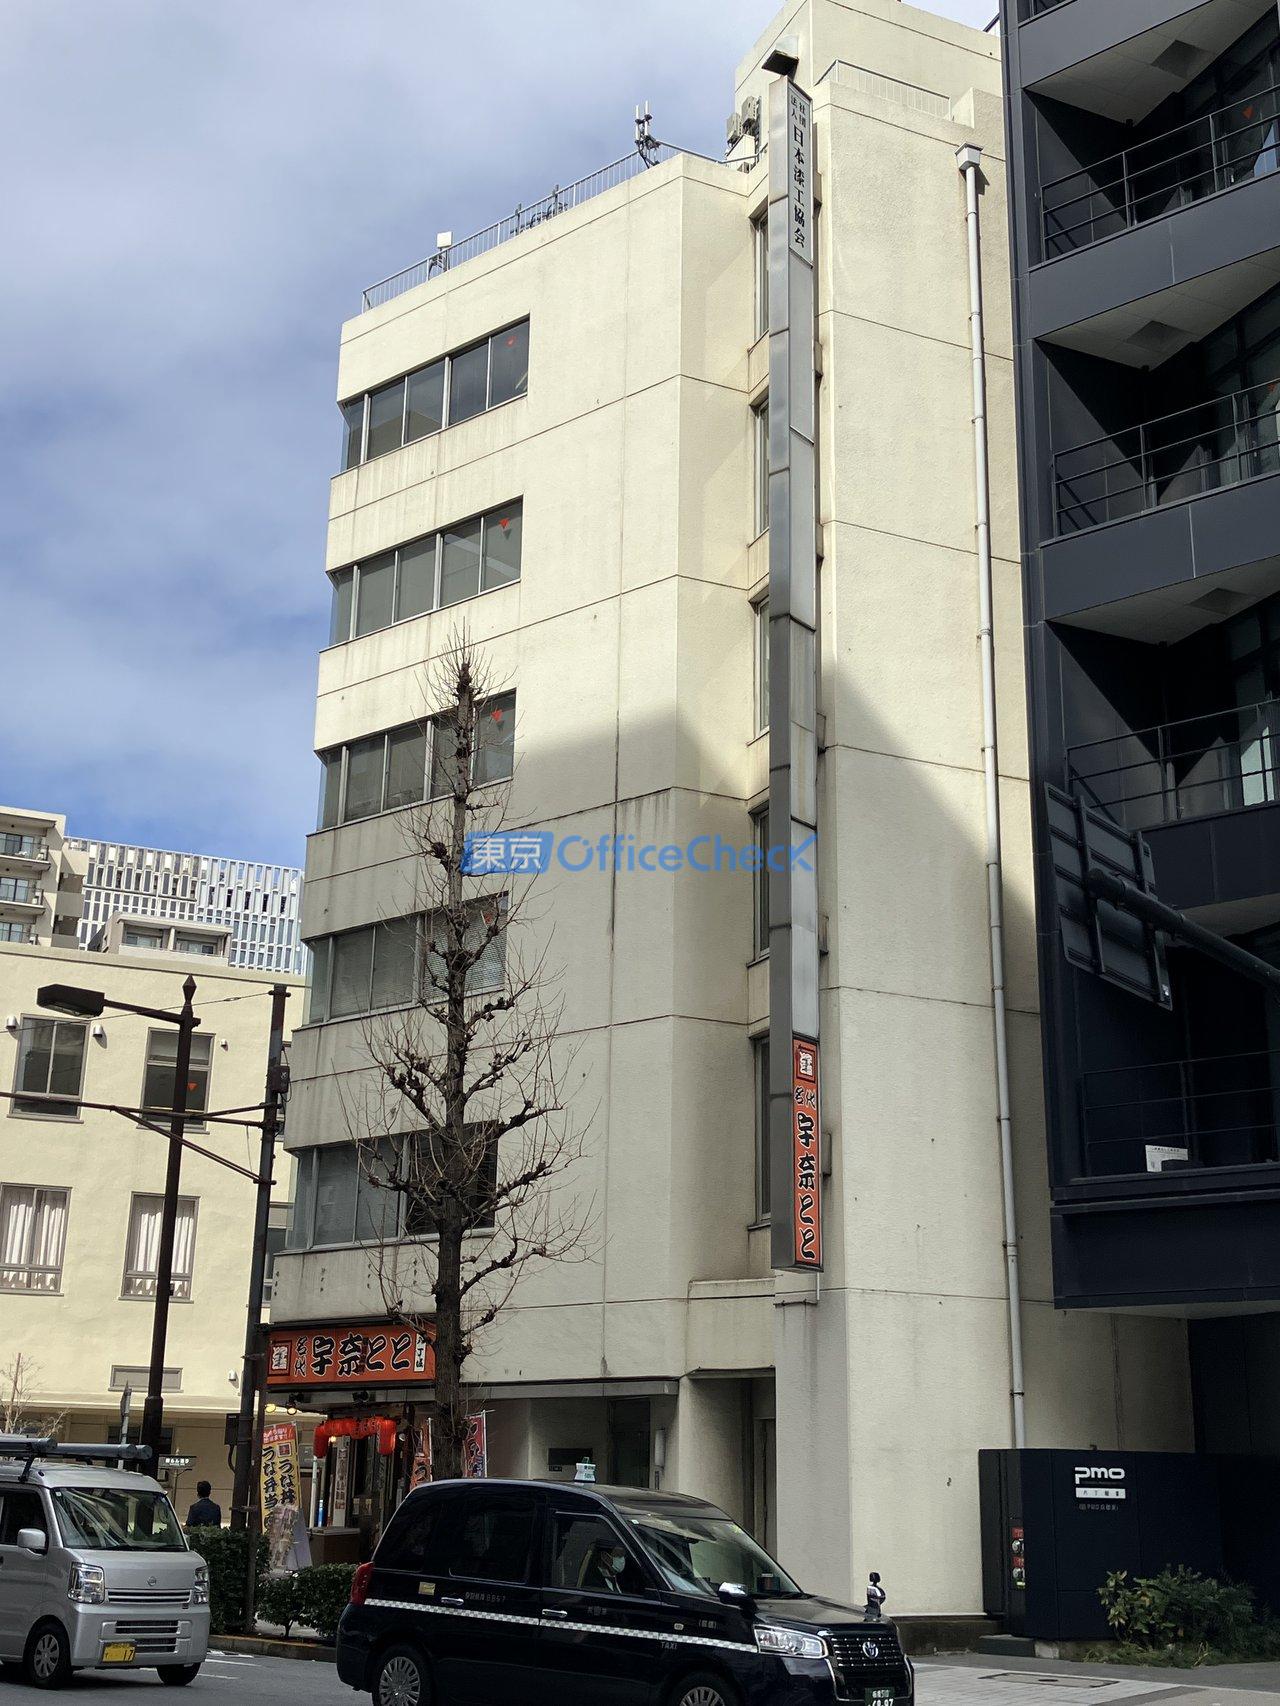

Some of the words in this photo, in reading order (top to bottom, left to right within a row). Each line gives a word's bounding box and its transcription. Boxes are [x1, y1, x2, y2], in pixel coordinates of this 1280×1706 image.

[796, 1112, 816, 1261] 宇奈とと
[311, 1331, 412, 1378] 宇奈とと
